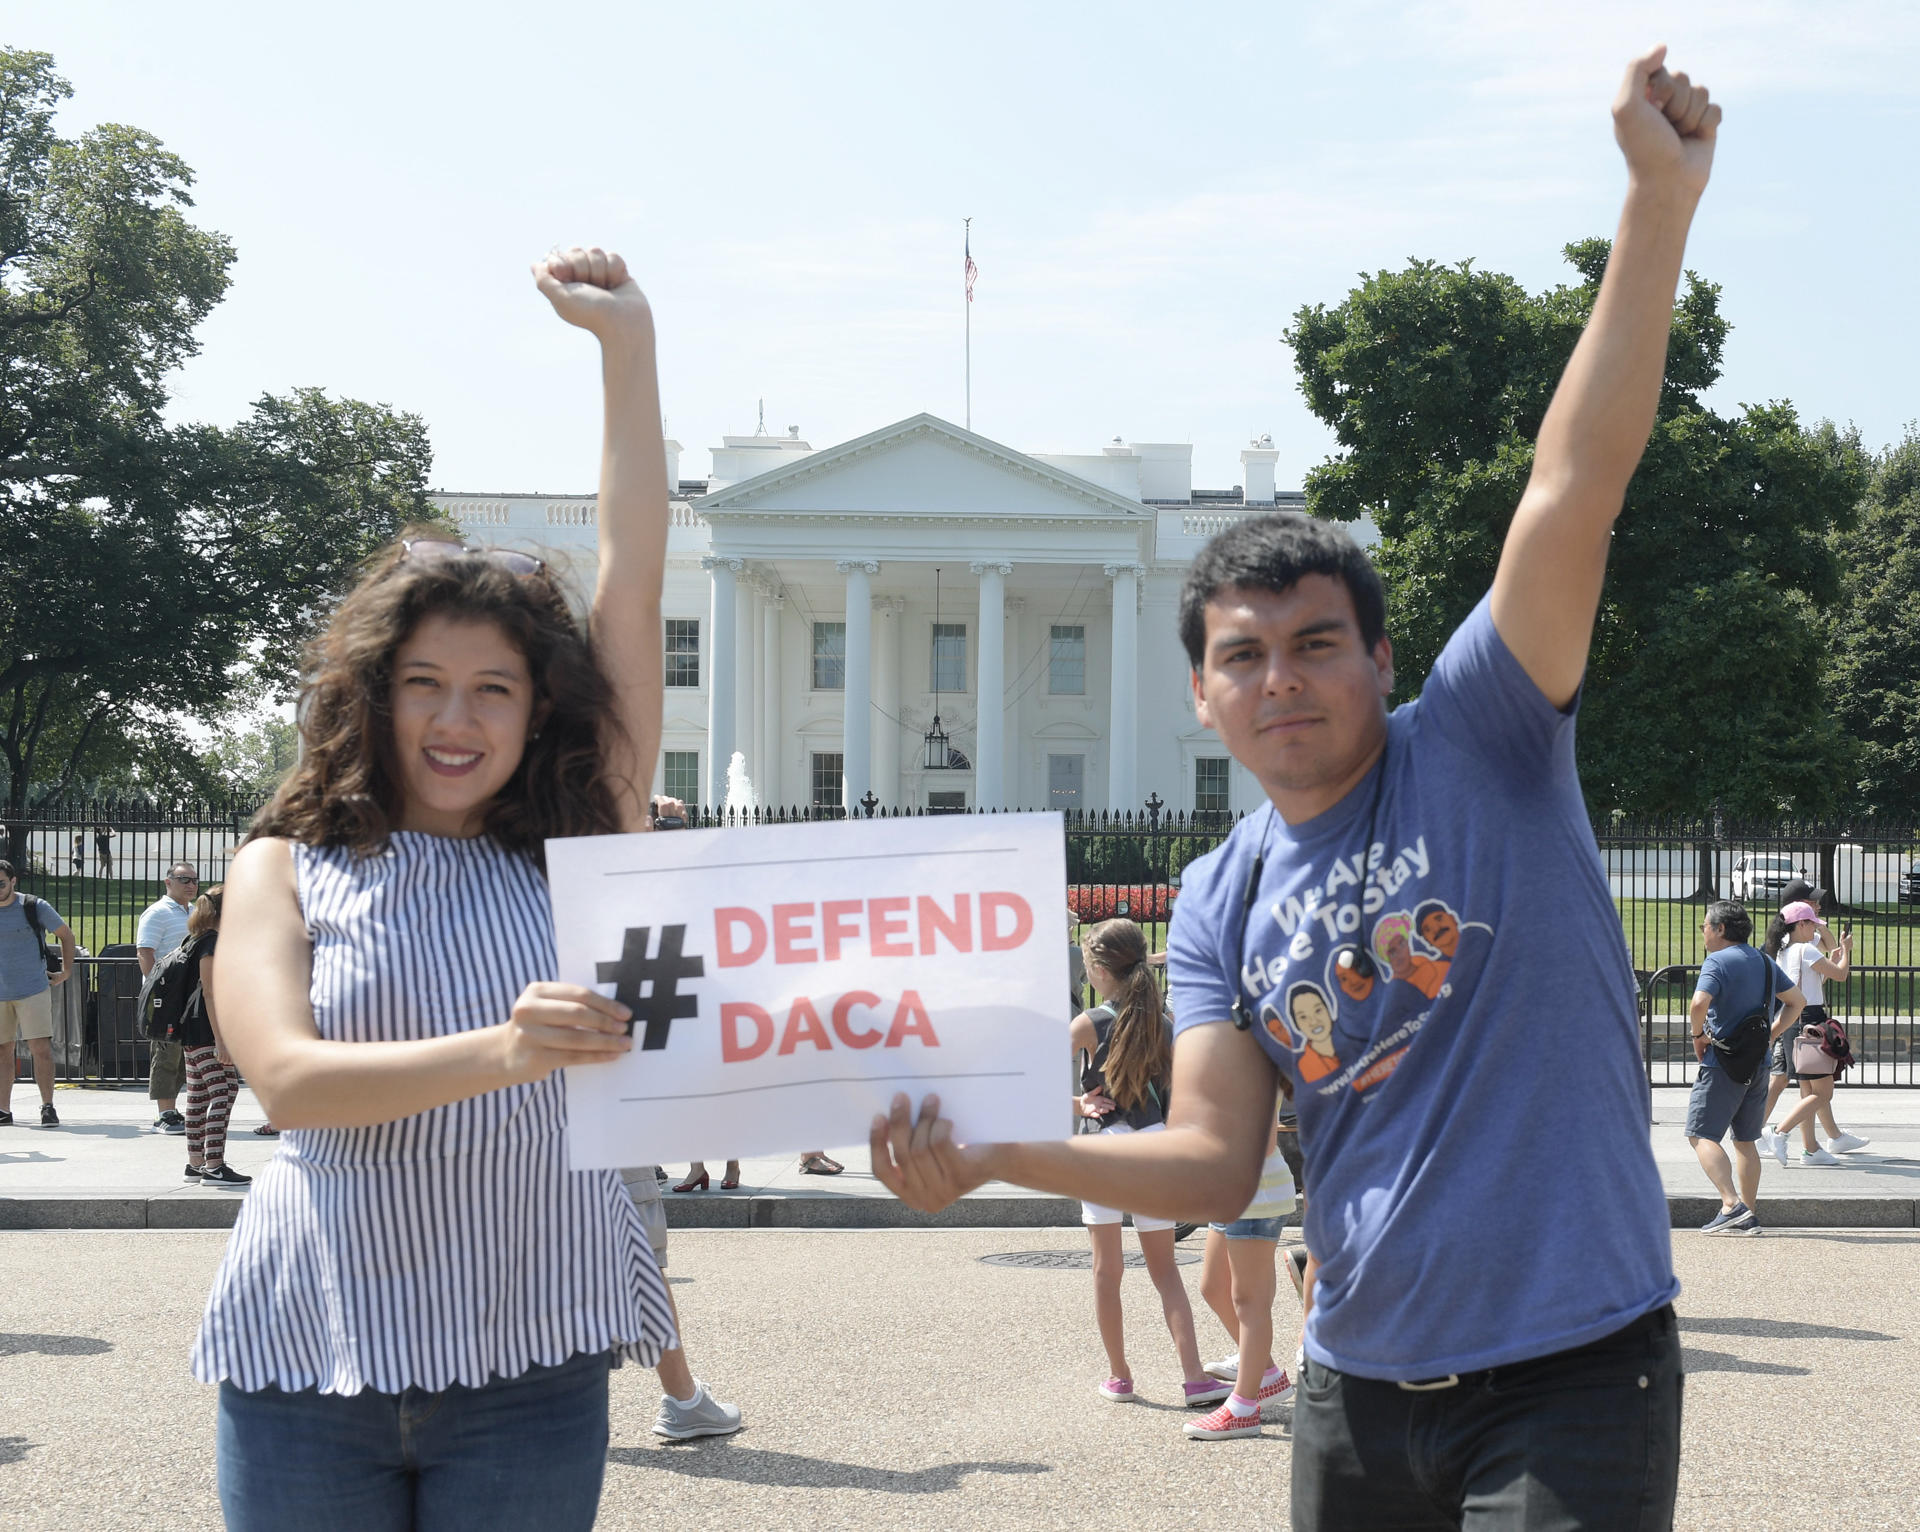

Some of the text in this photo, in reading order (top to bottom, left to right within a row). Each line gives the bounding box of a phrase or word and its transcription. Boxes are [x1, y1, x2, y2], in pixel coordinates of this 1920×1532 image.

[1326, 842, 1385, 896] Are
[715, 892, 1033, 967] DEFEND
[1241, 835, 1431, 997] Hee To Stay
[721, 990, 940, 1063] DACA
